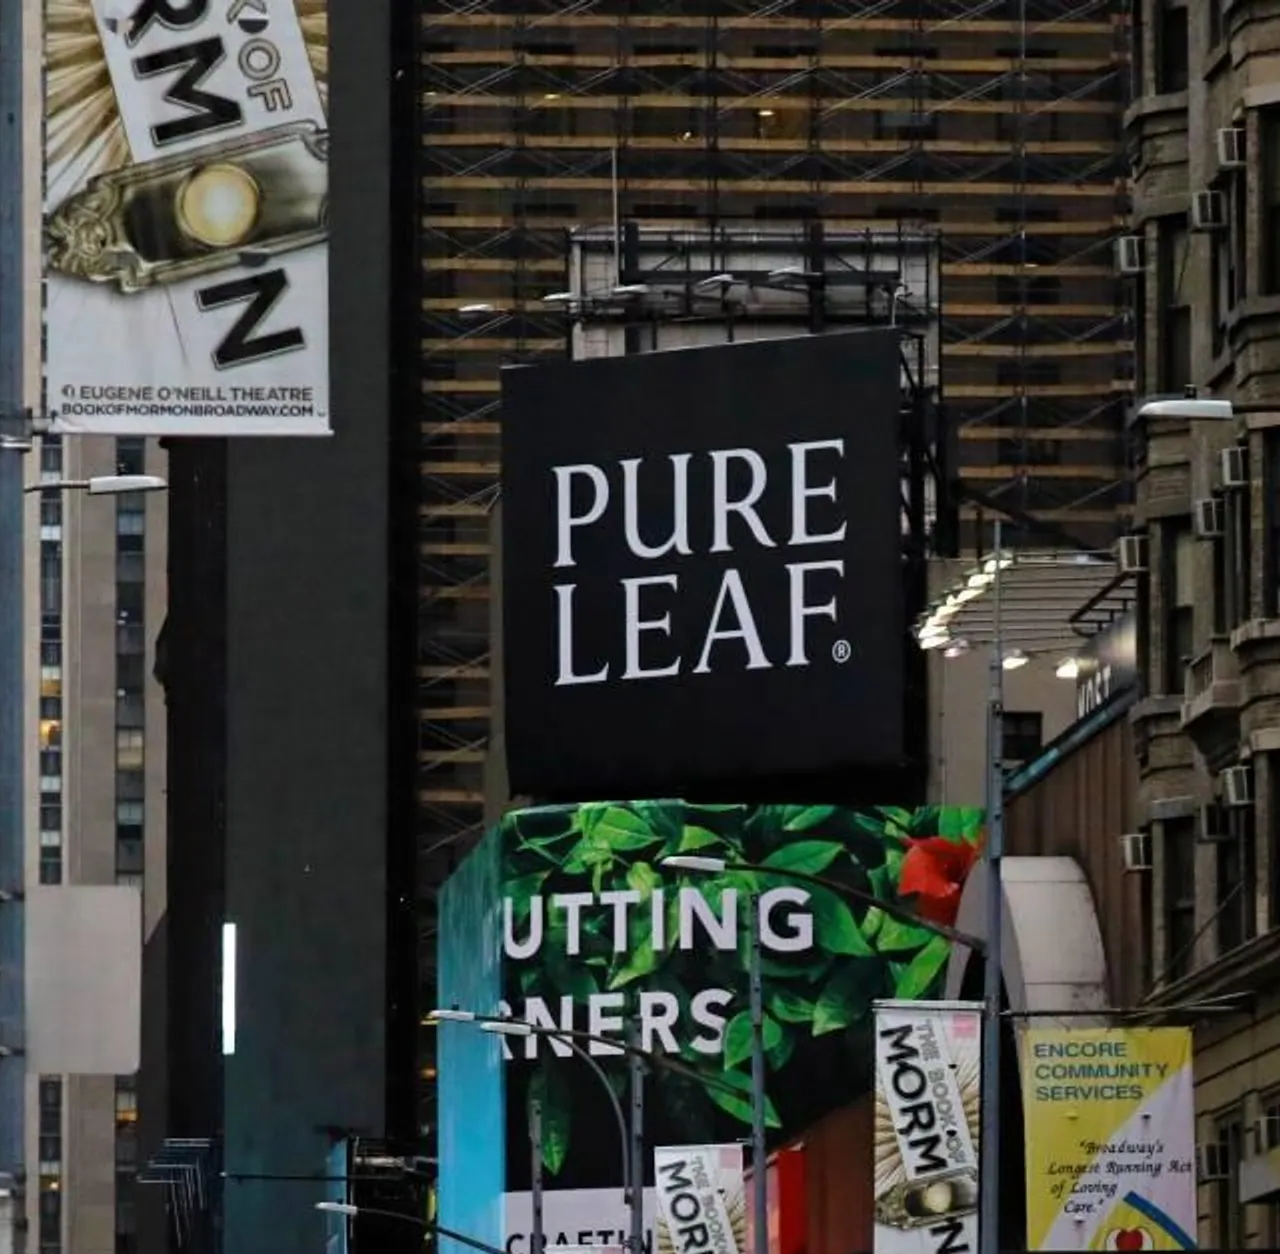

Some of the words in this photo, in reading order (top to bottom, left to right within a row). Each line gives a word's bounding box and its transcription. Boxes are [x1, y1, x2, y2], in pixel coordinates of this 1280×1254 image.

[80, 385, 152, 401] EUGENE
[158, 385, 226, 401] O'NEILL
[230, 386, 313, 402] THEATRE
[62, 403, 314, 418] BOOKOFMORMONBROADWAY.COM
[551, 437, 848, 568] PURE
[916, 1020, 939, 1060] THE
[1034, 1042, 1128, 1058] ENCORE
[1035, 1063, 1169, 1080] COMMUNITY
[1036, 1085, 1144, 1101] SERVICES
[1048, 1161, 1101, 1177] Longest
[1105, 1160, 1163, 1176] Running
[1050, 1179, 1066, 1197] of
[1069, 1179, 1118, 1197] Loving
